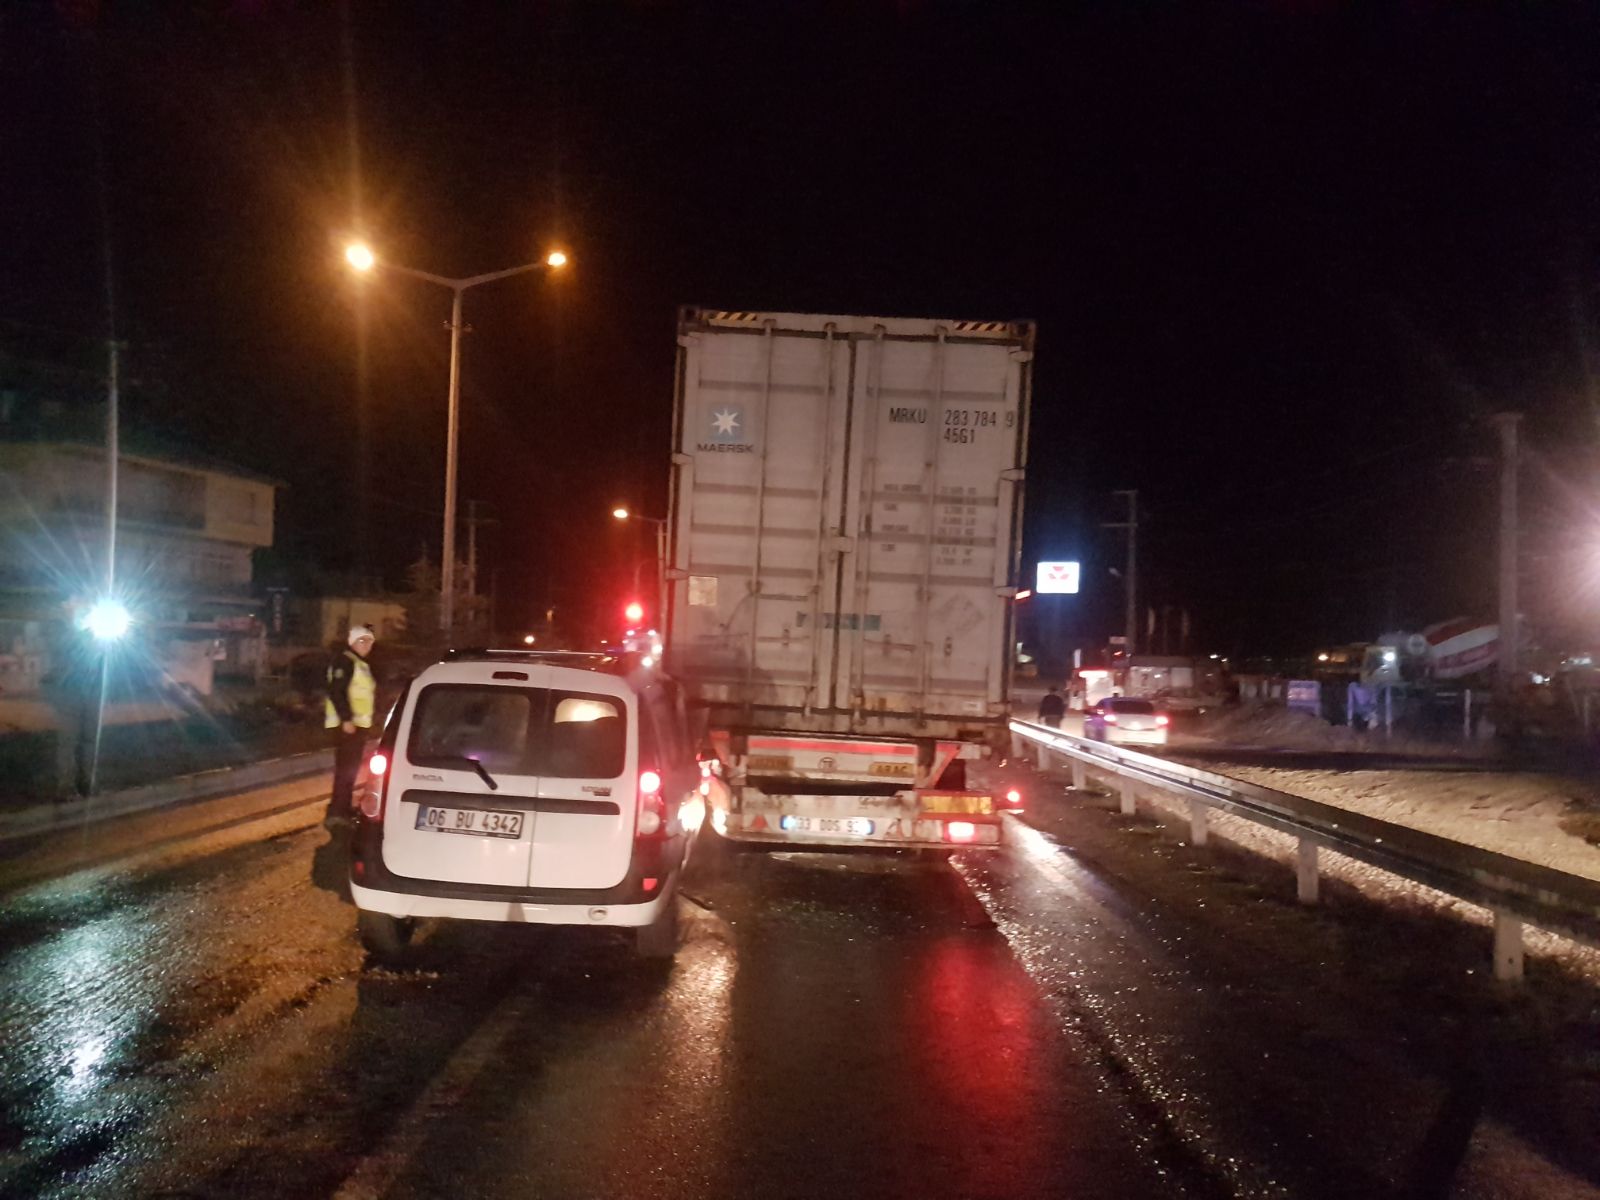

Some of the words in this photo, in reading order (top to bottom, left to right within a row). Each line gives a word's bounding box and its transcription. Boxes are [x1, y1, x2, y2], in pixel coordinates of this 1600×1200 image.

[888, 407, 927, 424] MRKU
[944, 409, 968, 426] 283
[974, 410, 997, 427] 784
[1005, 411, 1015, 428] 9
[943, 428, 975, 444] 45G1
[697, 443, 754, 453] MAERSK
[428, 809, 446, 827] 06
[455, 811, 475, 829] BU
[481, 813, 519, 834] 4342
